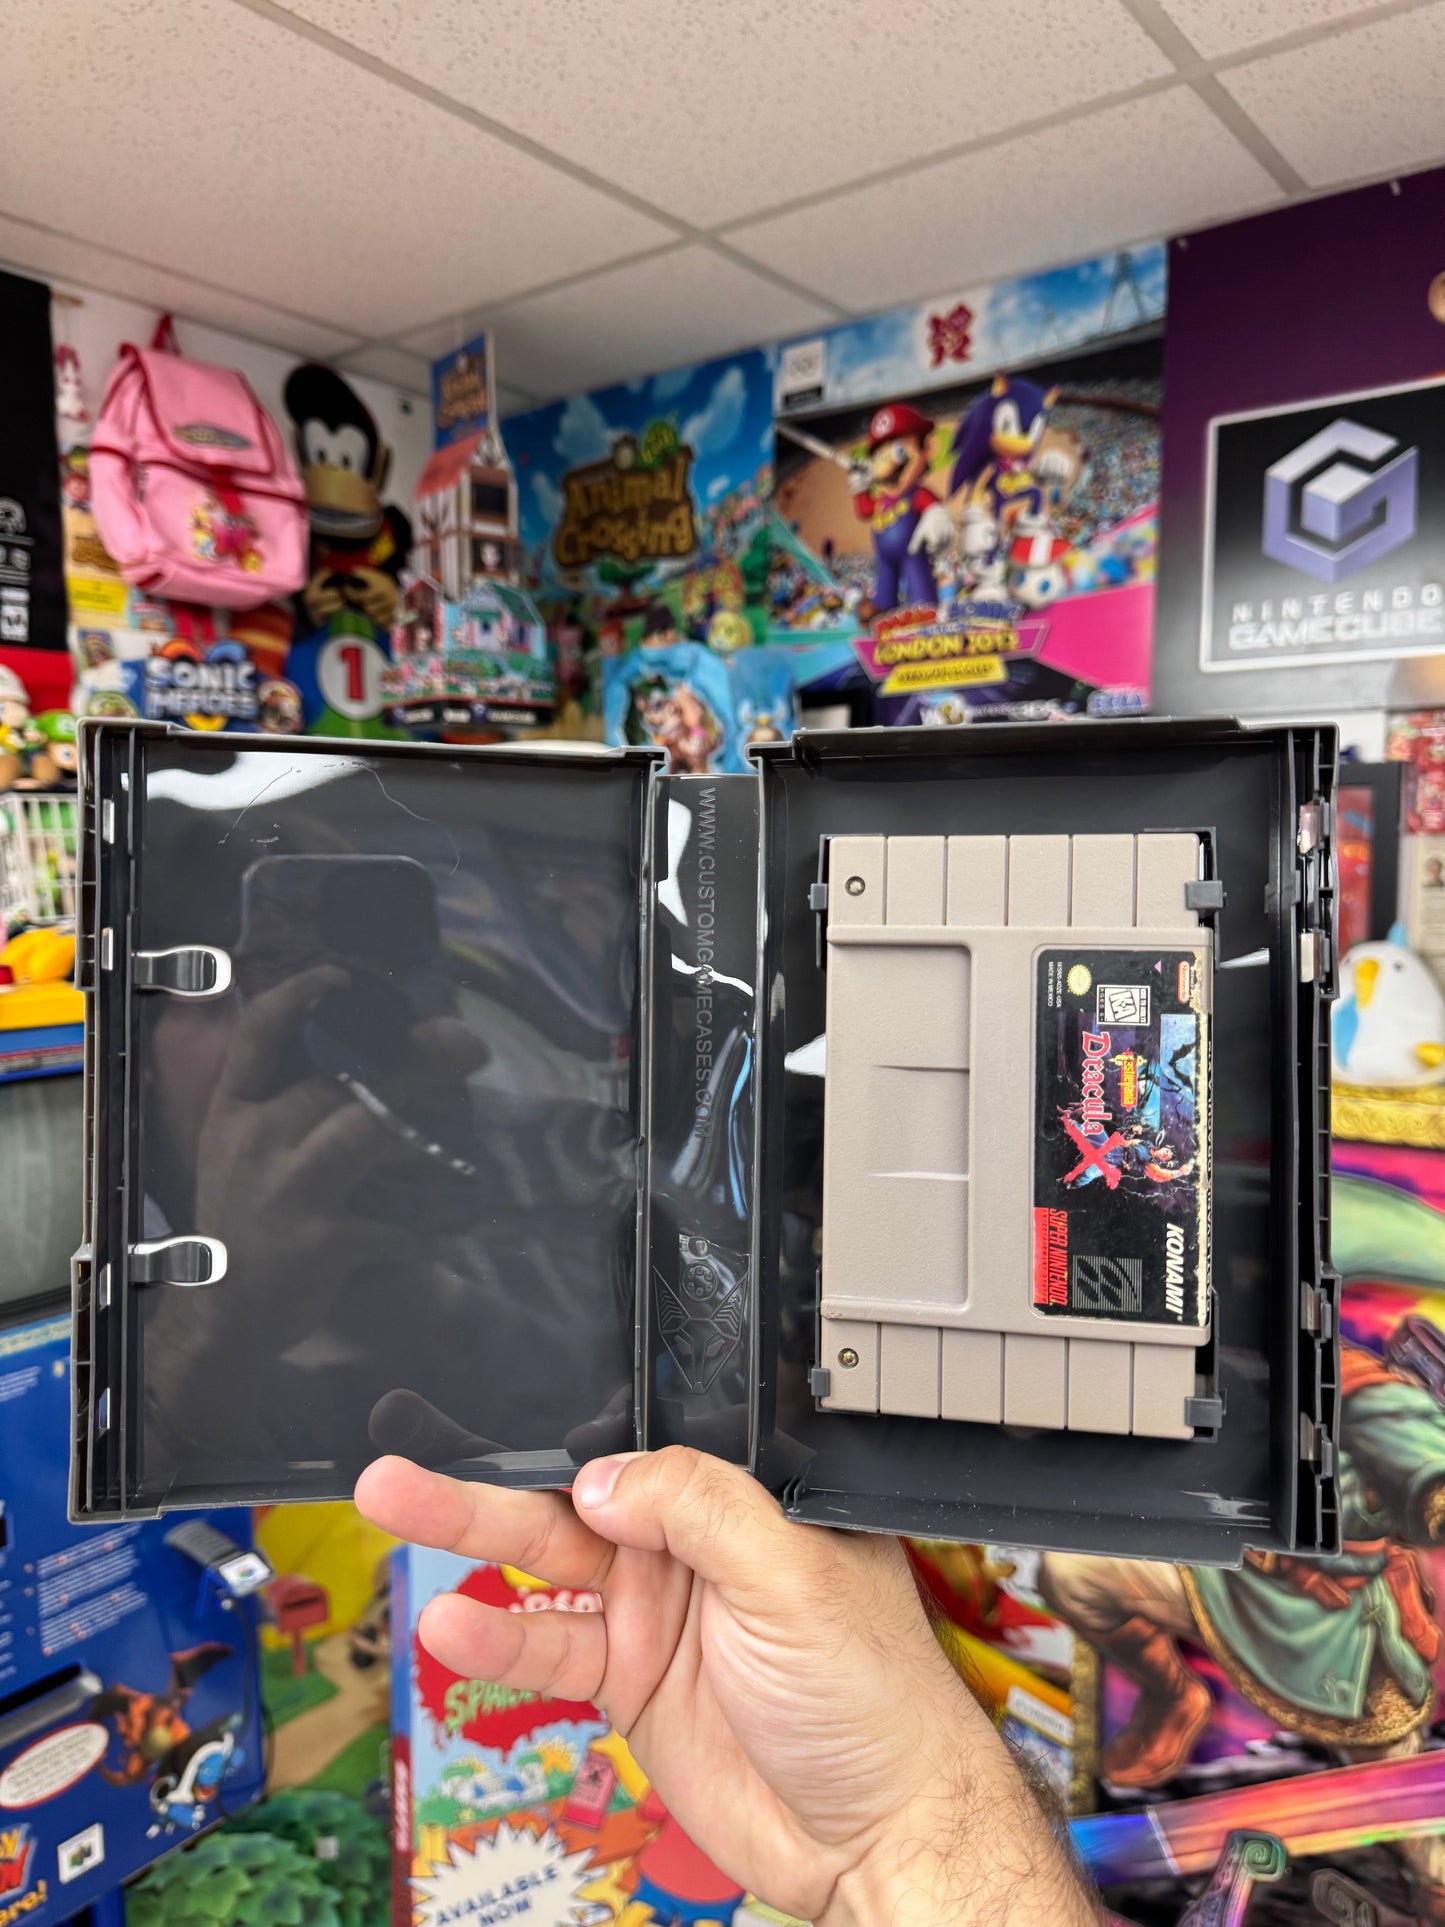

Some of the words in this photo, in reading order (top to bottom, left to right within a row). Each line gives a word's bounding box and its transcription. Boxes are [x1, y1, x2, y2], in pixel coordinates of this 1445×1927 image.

[1231, 582, 1443, 624] NINTENDO
[874, 635, 965, 666] LONDON
[1228, 606, 1445, 650] GAMECUBE
[145, 656, 257, 690] SONIC
[340, 647, 363, 701] 1
[1081, 1030, 1113, 1137] Dracula
[1062, 1115, 1122, 1191] X
[1049, 1208, 1068, 1247] SUPER
[1049, 1247, 1068, 1305] NINTENDO
[1164, 1222, 1185, 1316] KONAMI
[436, 1863, 558, 1926] AVAILABLE
[479, 1896, 532, 1927] NOW
